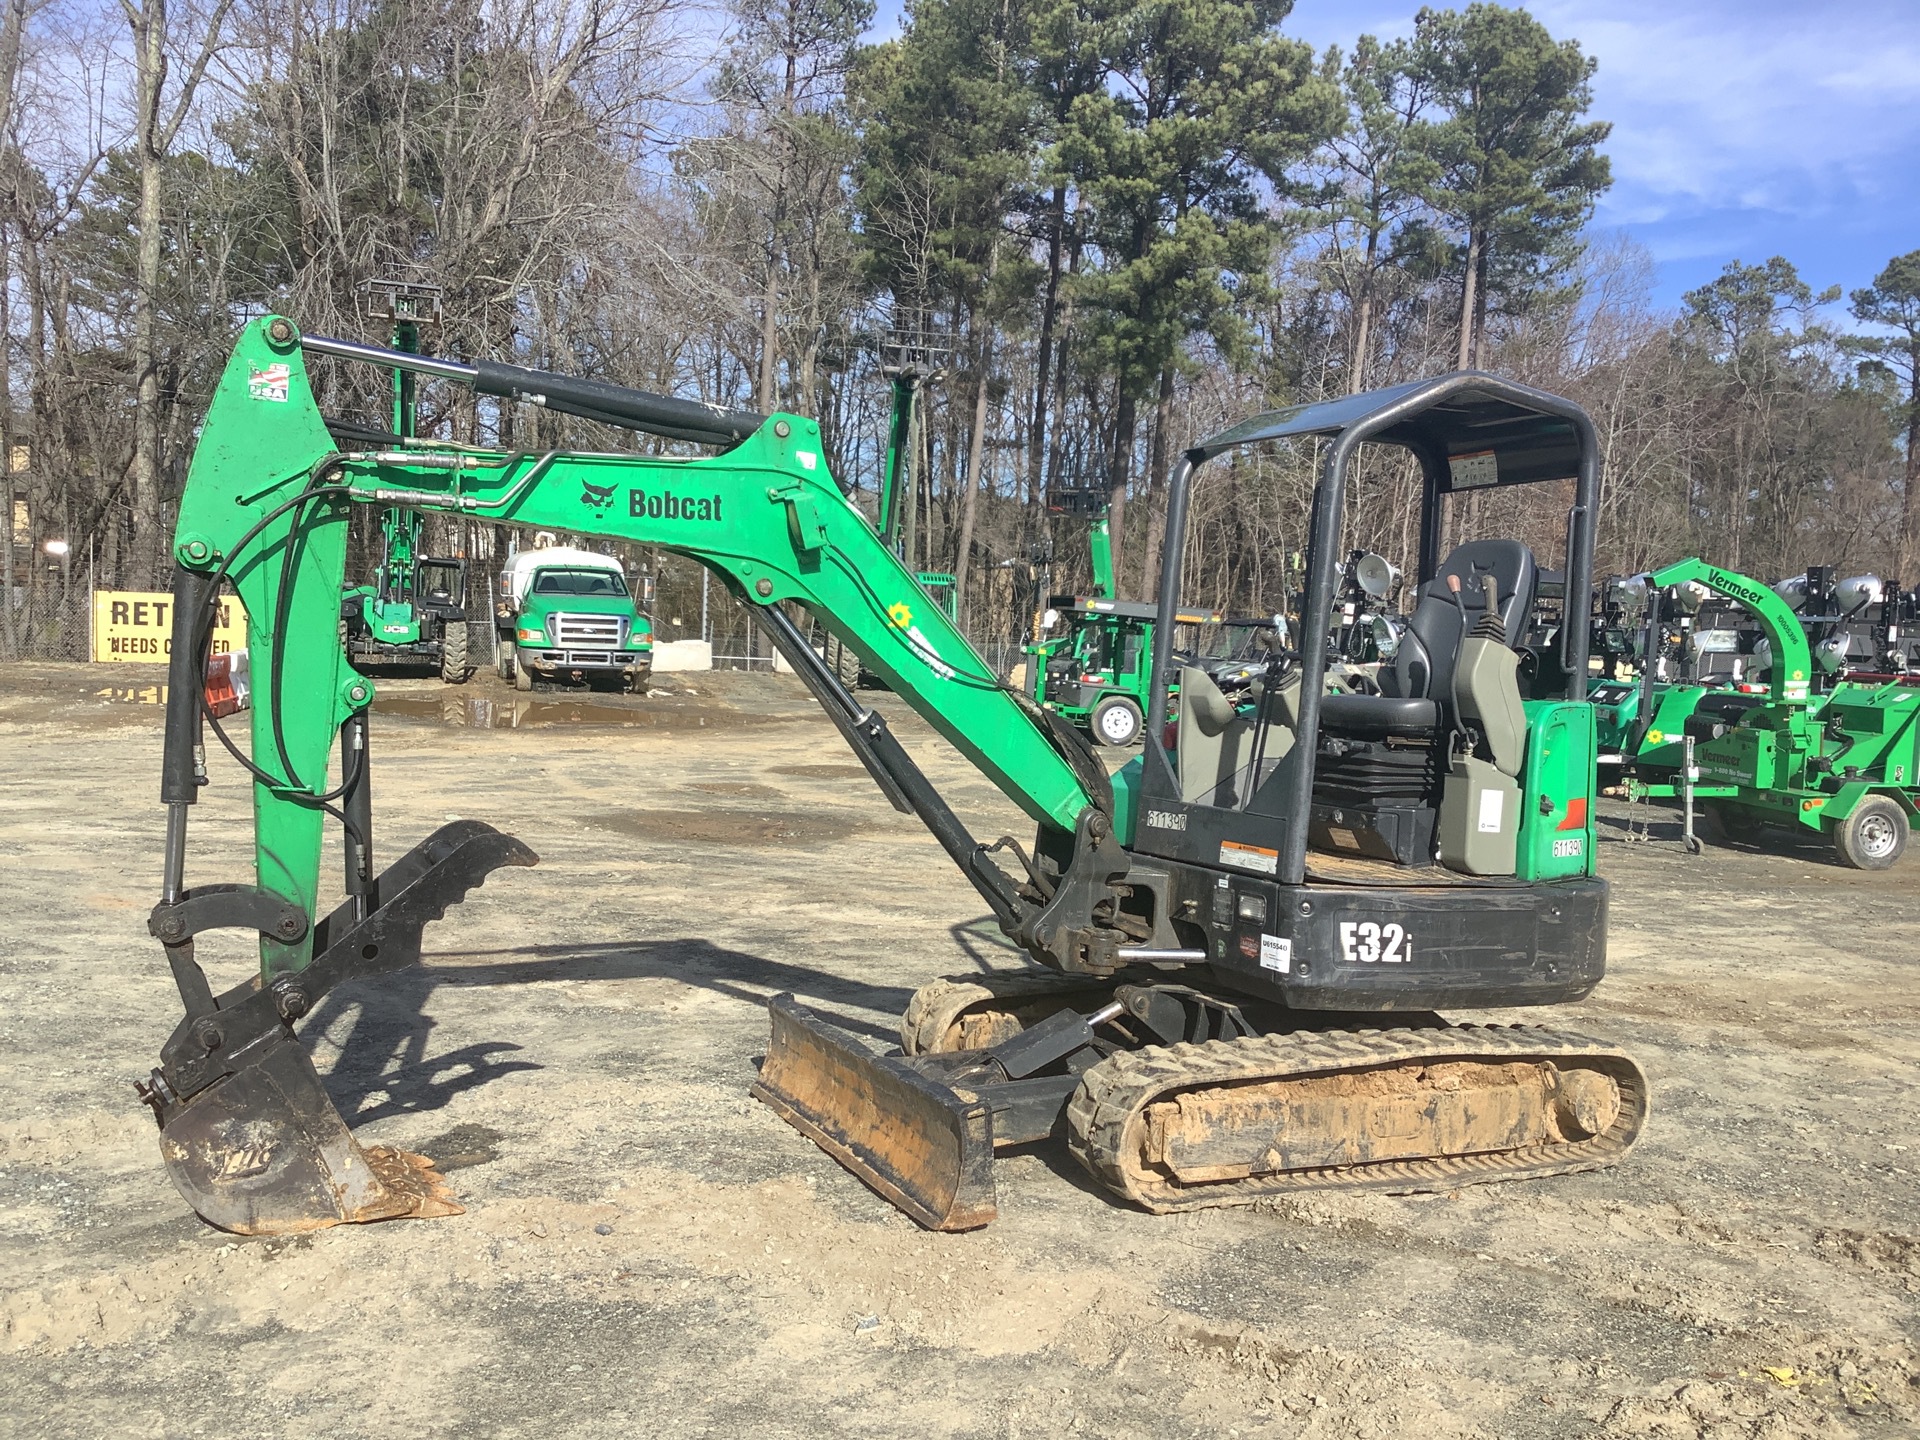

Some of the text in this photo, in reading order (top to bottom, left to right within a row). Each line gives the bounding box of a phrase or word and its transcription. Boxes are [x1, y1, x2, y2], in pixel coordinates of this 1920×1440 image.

[629, 488, 722, 521] Bobcat
[1708, 568, 1764, 605] Vermeer
[112, 601, 230, 628] RETN
[384, 625, 409, 634] JCB
[111, 636, 158, 654] NEEDS
[1702, 748, 1740, 766] Vermeer
[1340, 922, 1413, 963] E32i
